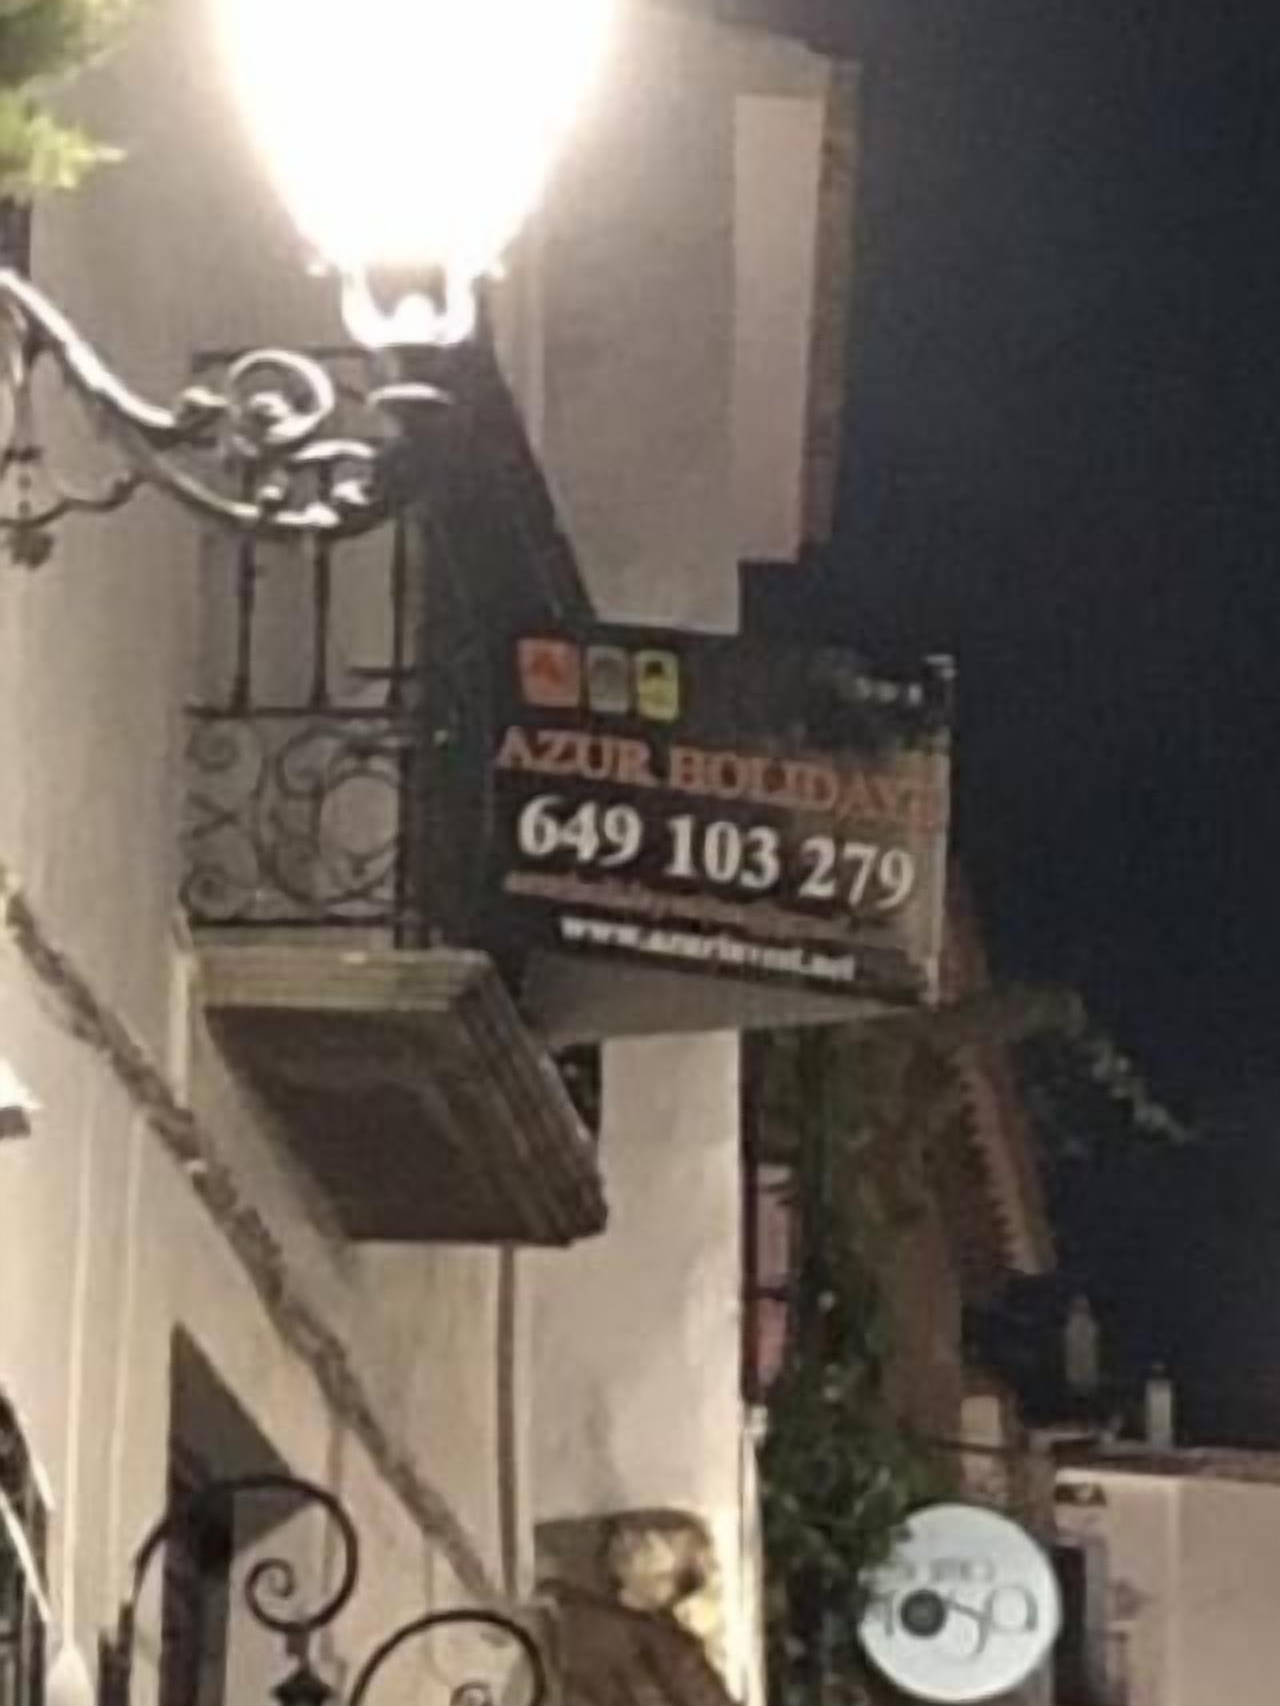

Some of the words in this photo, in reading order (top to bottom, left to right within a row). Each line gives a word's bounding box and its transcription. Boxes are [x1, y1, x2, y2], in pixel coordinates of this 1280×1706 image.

[499, 726, 660, 786] AZUR
[517, 795, 643, 867] 649
[665, 815, 781, 890] 103
[799, 836, 916, 910] 279
